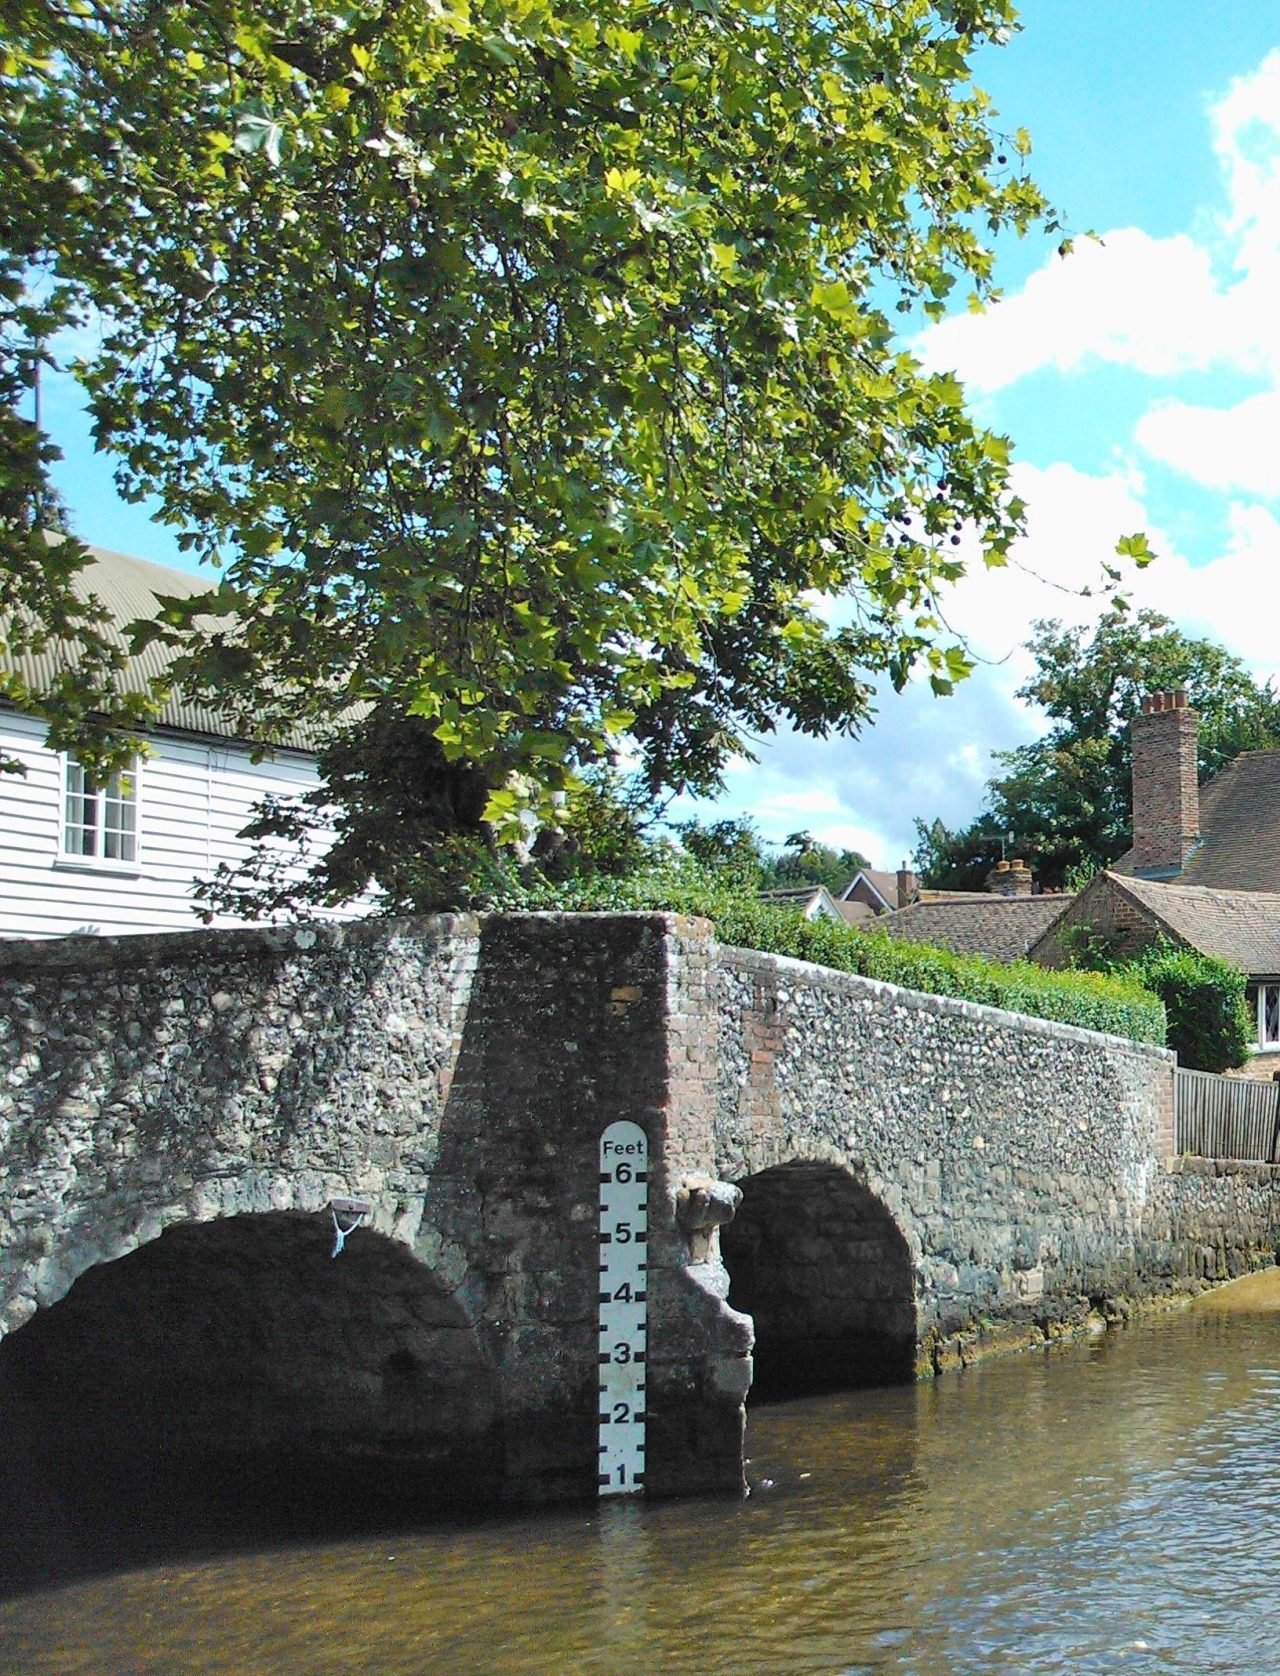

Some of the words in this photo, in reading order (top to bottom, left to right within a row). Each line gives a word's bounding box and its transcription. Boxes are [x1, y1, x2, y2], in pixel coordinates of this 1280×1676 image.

[603, 1140, 644, 1156] Feet
[615, 1162, 632, 1185] 6
[615, 1223, 631, 1244] 5
[613, 1282, 632, 1303] 4
[614, 1343, 631, 1364] 3
[614, 1403, 630, 1424] 2
[617, 1465, 626, 1485] 1
